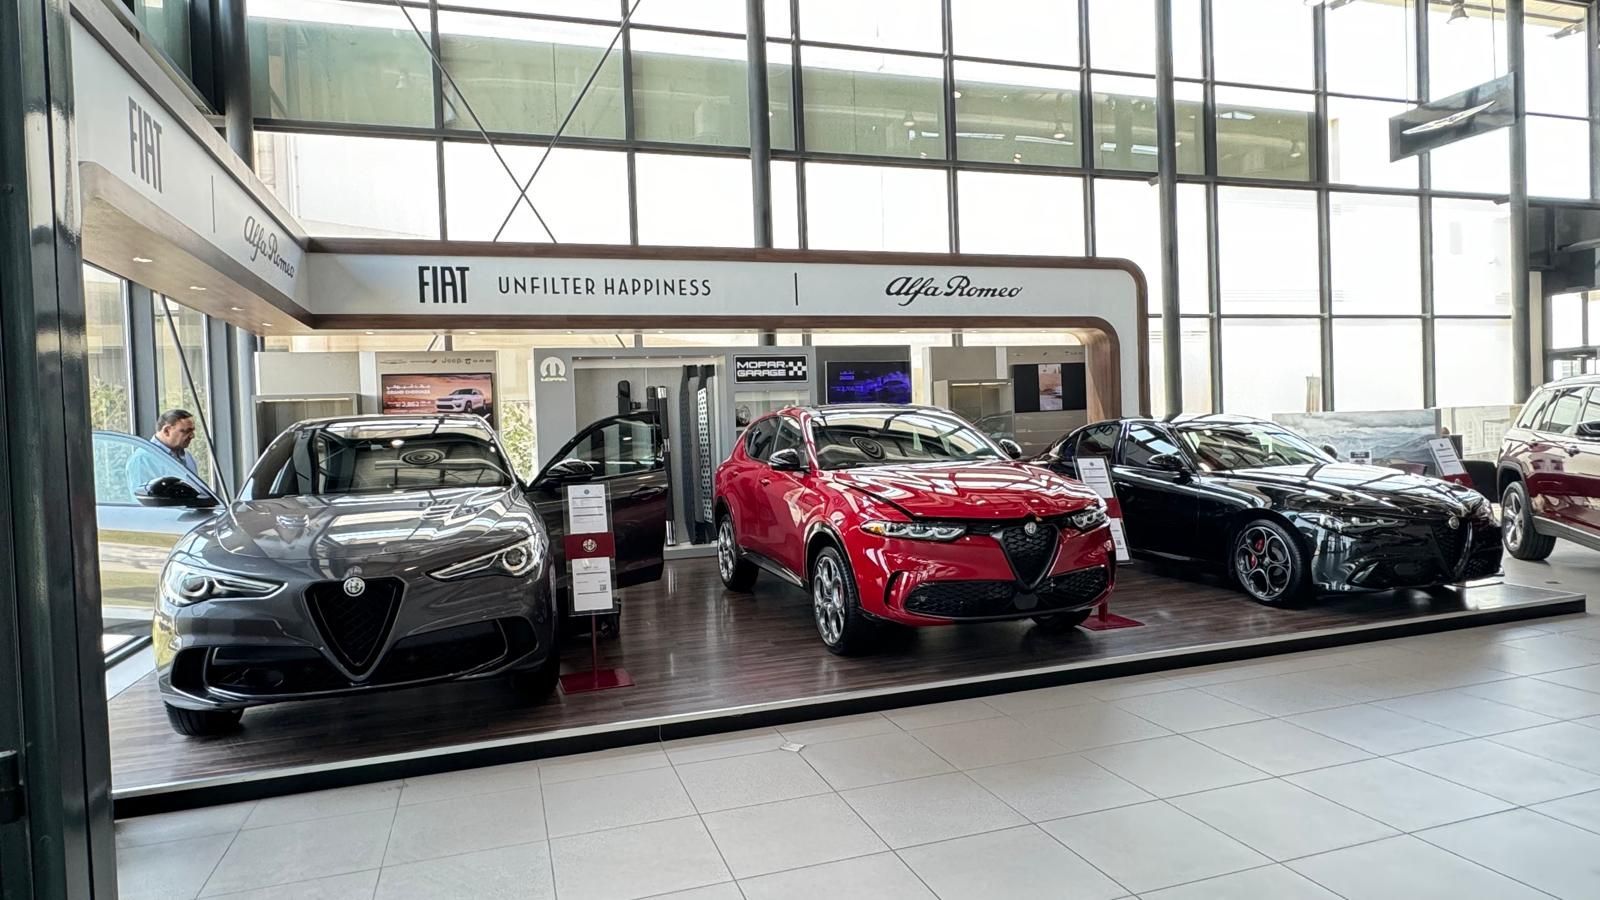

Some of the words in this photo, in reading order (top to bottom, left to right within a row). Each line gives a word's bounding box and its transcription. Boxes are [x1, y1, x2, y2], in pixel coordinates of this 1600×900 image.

[128, 96, 162, 193] FIAT
[243, 216, 267, 262] Alfa
[267, 232, 295, 278] Romeo
[418, 266, 469, 303] FIAT
[498, 276, 595, 295] UNFILTER
[604, 278, 711, 296] HAPPINESS
[885, 276, 942, 306] Alfa
[943, 275, 1023, 298] Romeo
[441, 356, 462, 364] Jeep
[736, 361, 785, 369] MOPAR
[737, 369, 786, 377] GARAGE
